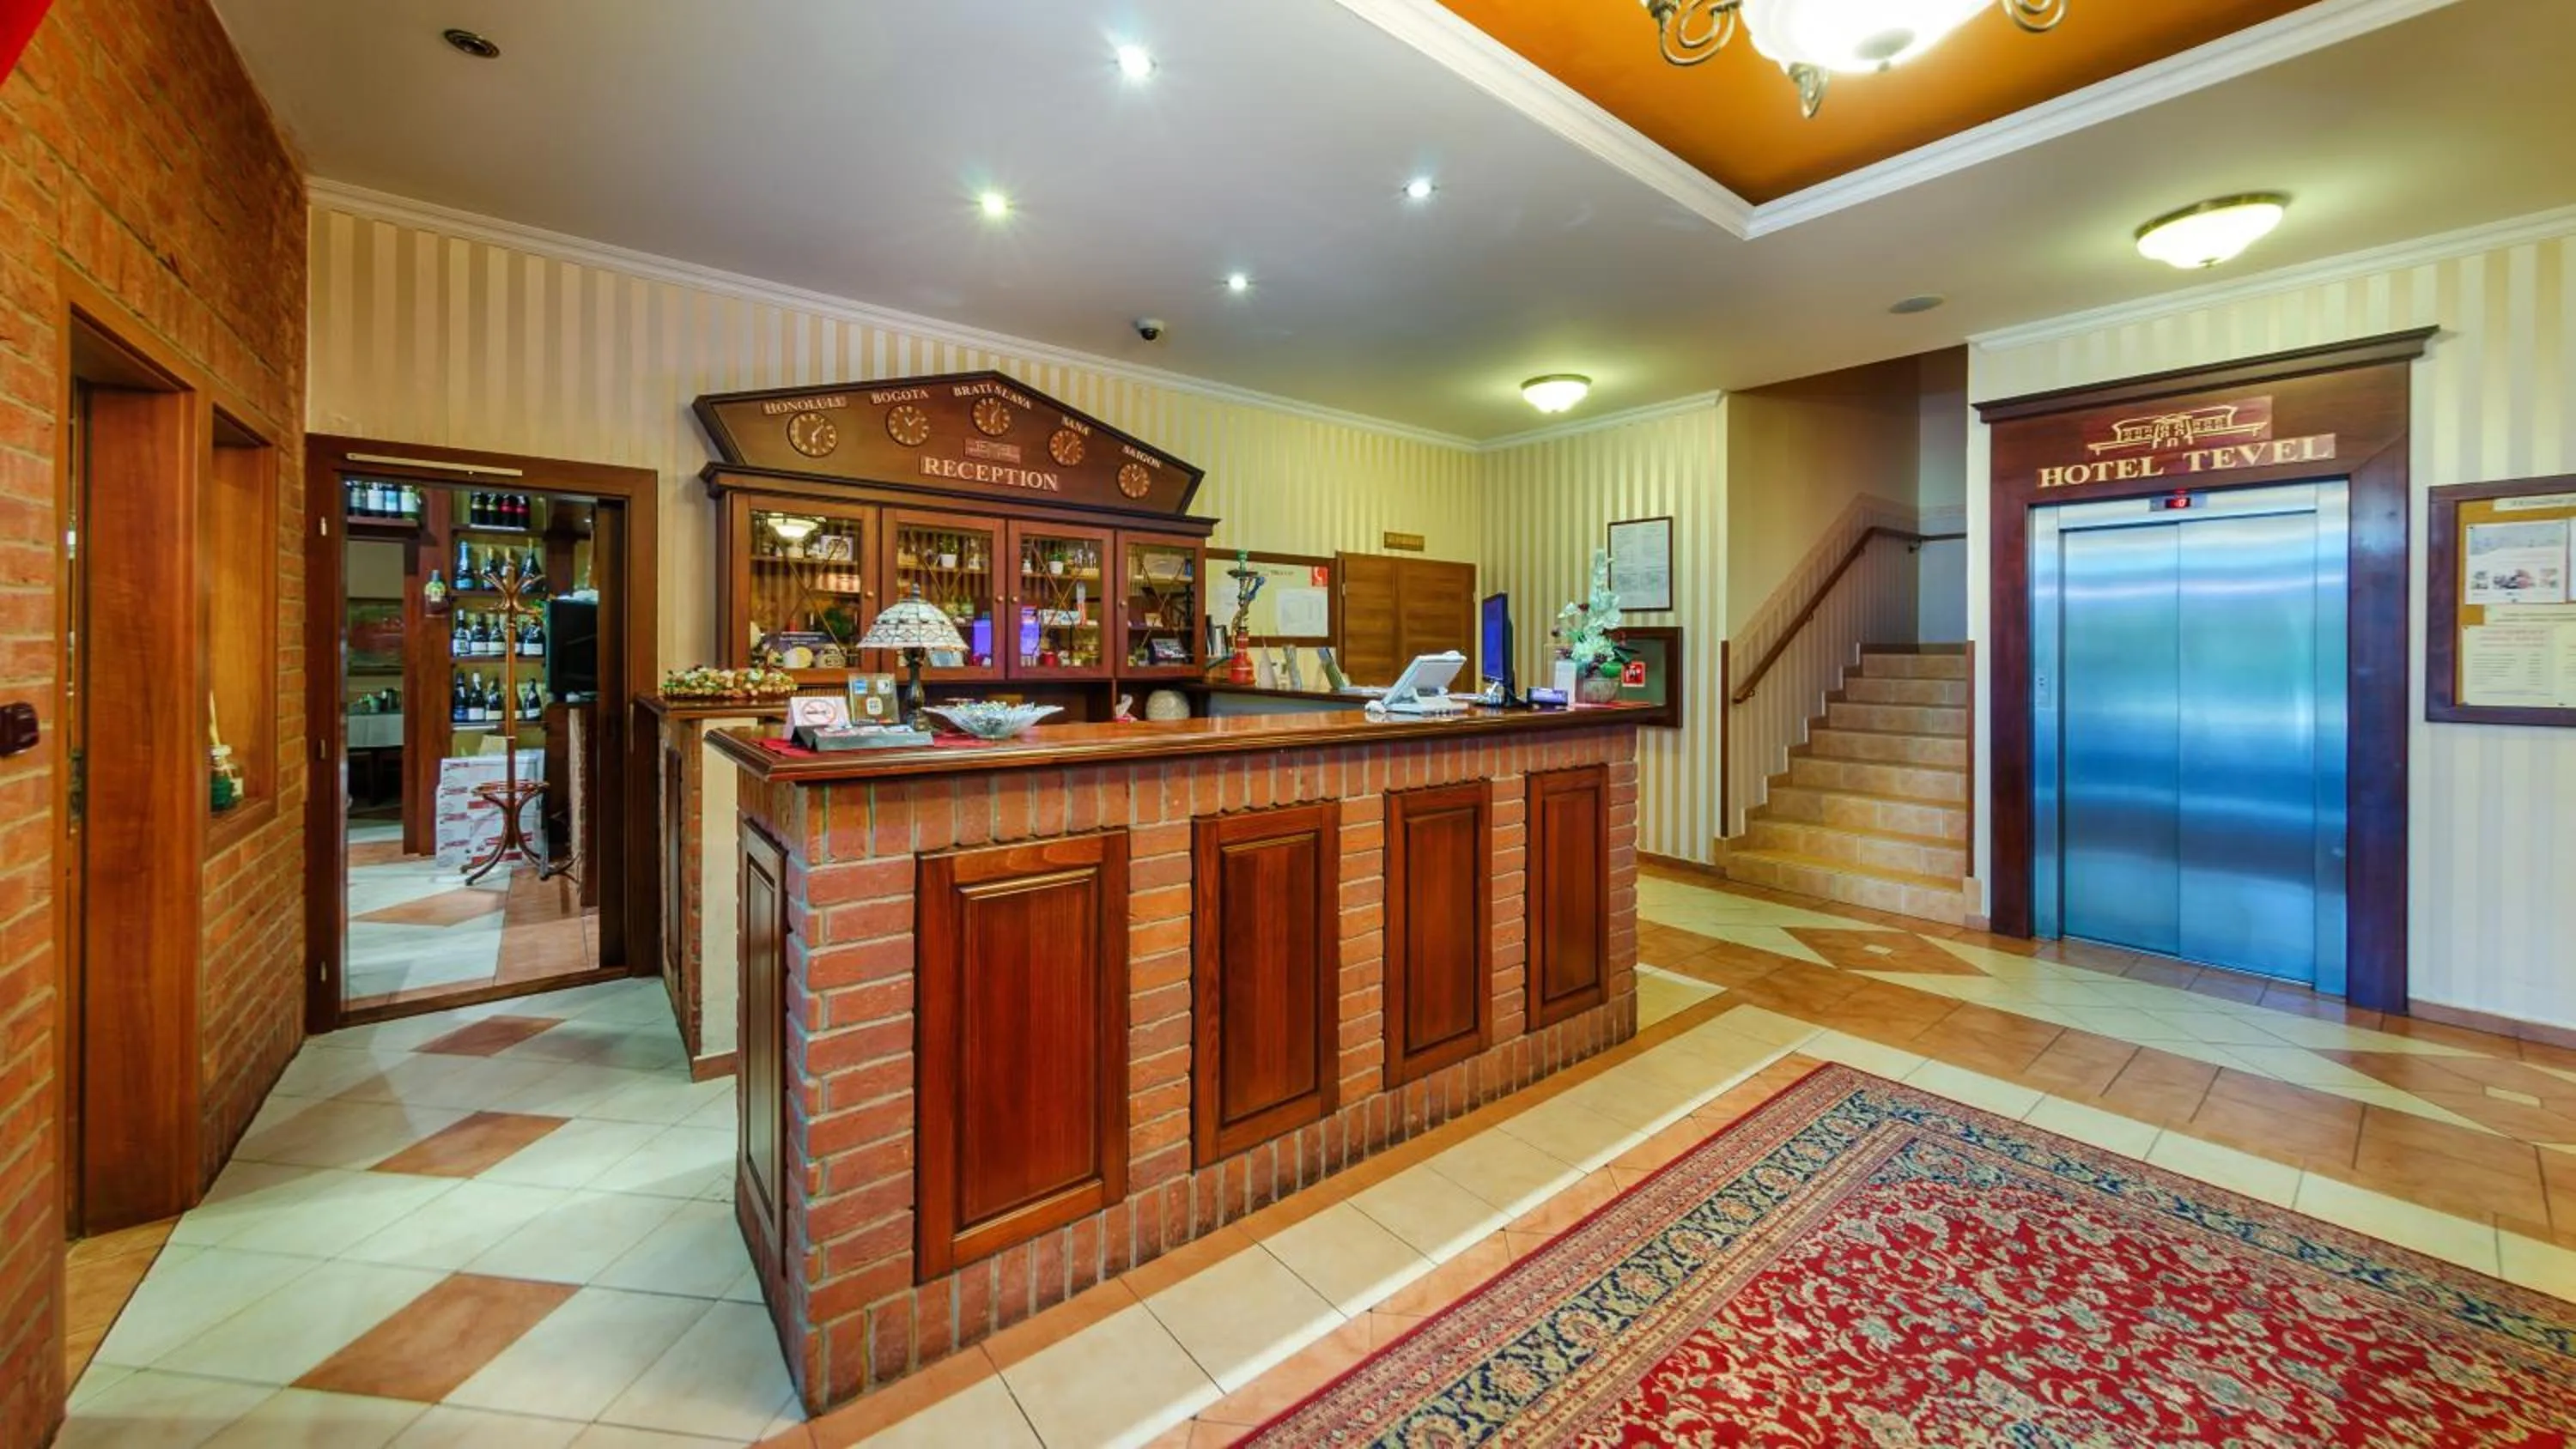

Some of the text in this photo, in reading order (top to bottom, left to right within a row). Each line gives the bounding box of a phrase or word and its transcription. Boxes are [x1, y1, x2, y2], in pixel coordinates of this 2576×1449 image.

[871, 390, 929, 404] BOGOTA
[924, 456, 1059, 491] RECEPTION
[2038, 434, 2330, 488] HOTEL TEVEL
